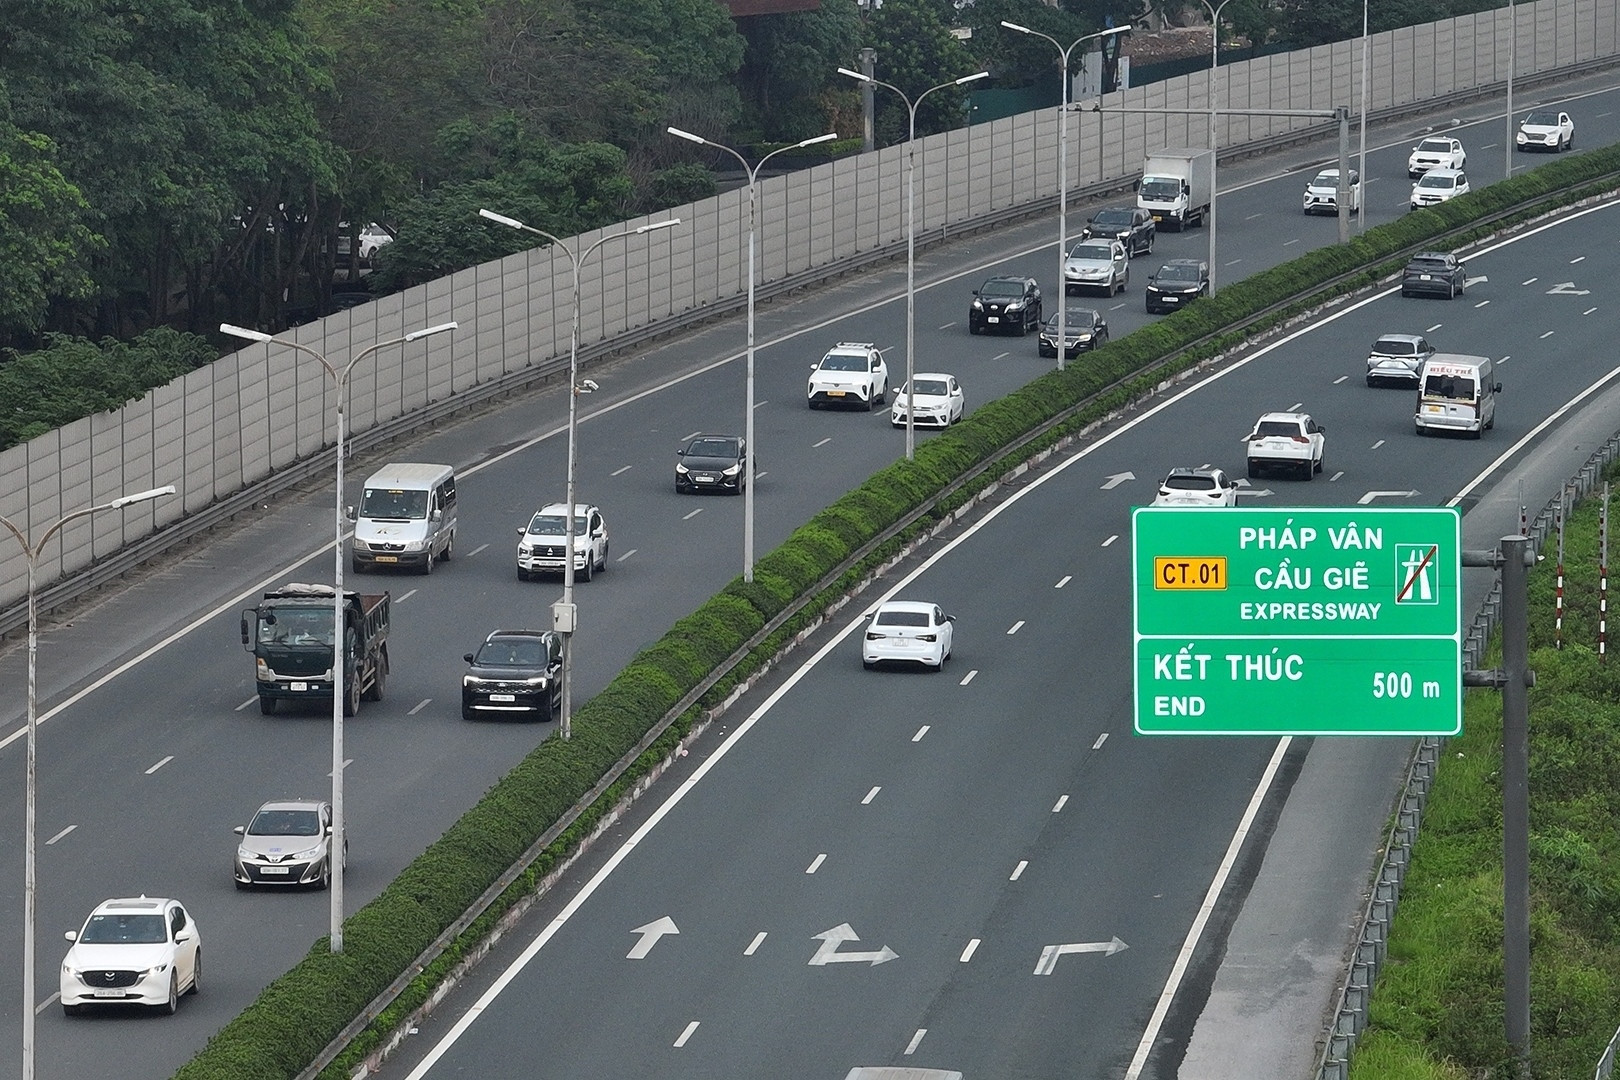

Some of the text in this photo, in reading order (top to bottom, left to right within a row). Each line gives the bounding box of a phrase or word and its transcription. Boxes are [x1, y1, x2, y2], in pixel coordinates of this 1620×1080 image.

[1240, 518, 1383, 550] PHÁP VÂN
[1163, 563, 1219, 584] CT.01
[1254, 557, 1369, 590] CẦU GIẼ
[1240, 602, 1382, 620] EXPRESSWAY
[1154, 643, 1304, 681] KẾT THÚC
[1373, 672, 1440, 698] 500 m
[1154, 696, 1206, 716] END
